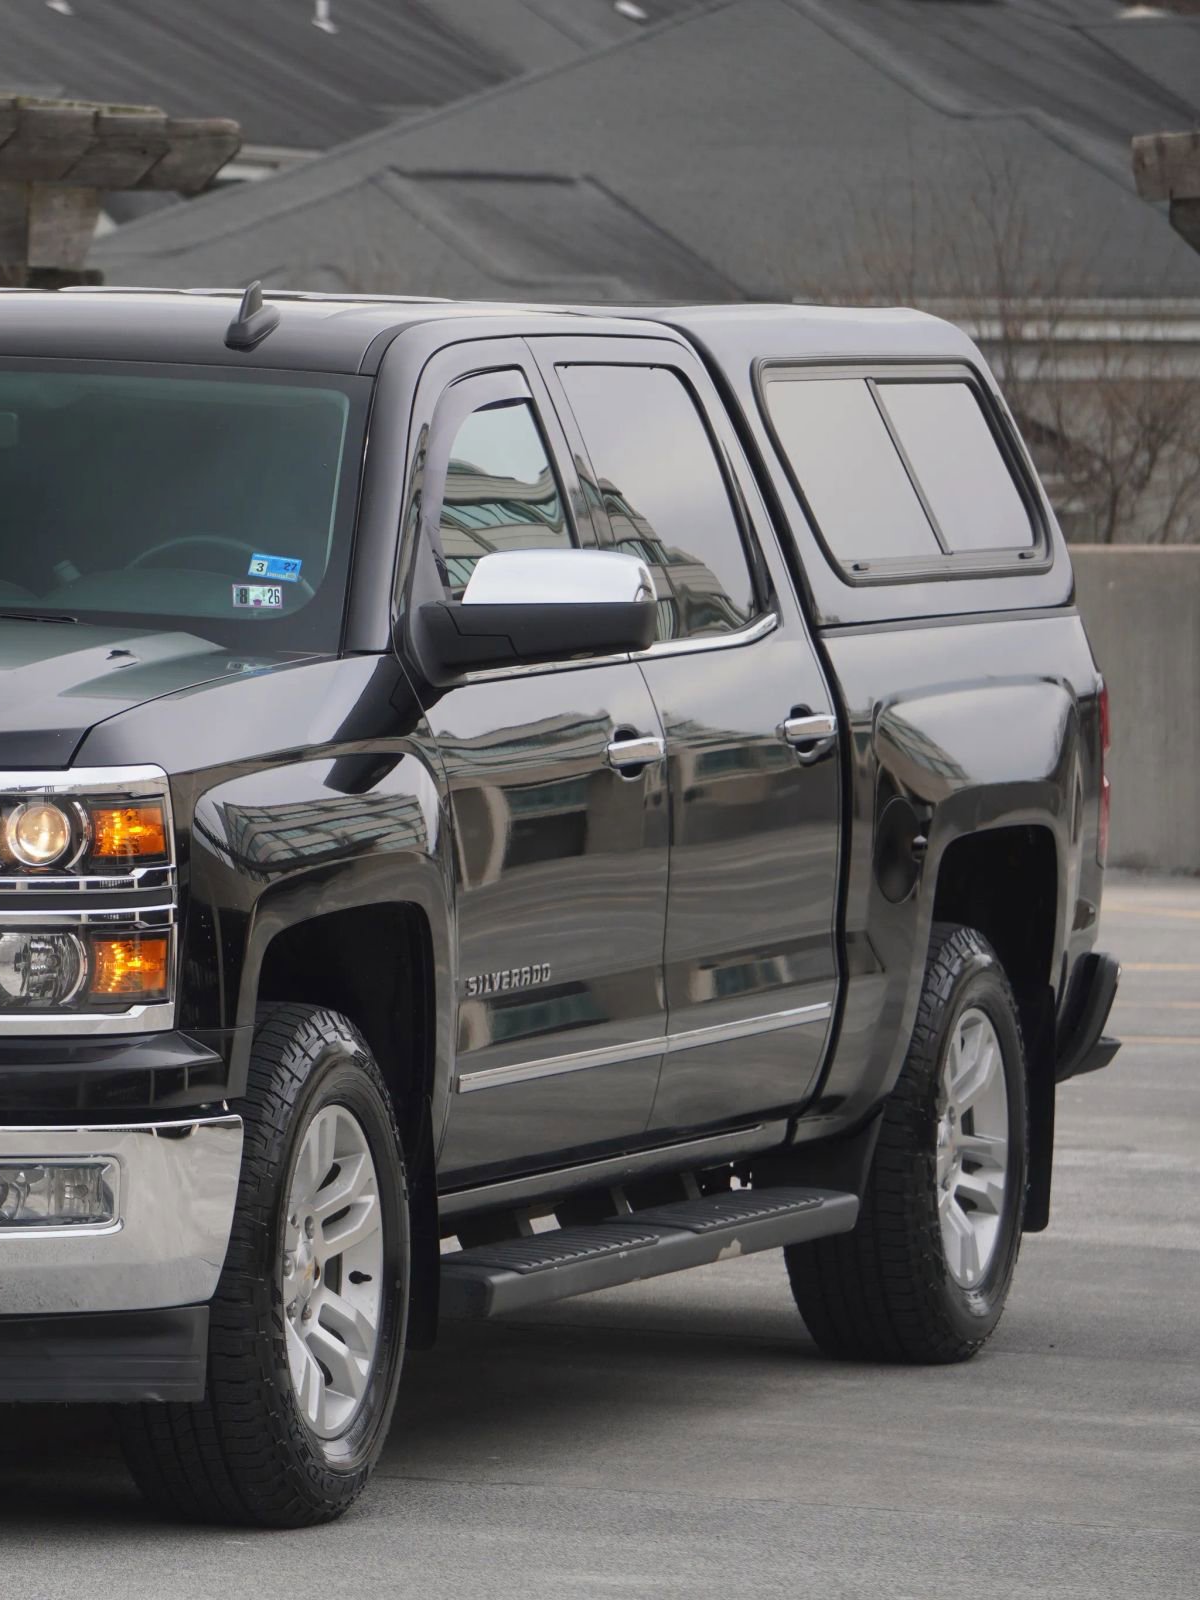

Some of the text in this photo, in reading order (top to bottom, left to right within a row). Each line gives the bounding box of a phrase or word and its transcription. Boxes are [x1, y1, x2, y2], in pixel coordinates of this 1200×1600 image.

[256, 562, 298, 573] 3 27
[239, 588, 280, 604] 8 26
[466, 963, 551, 996] SILVERADO
